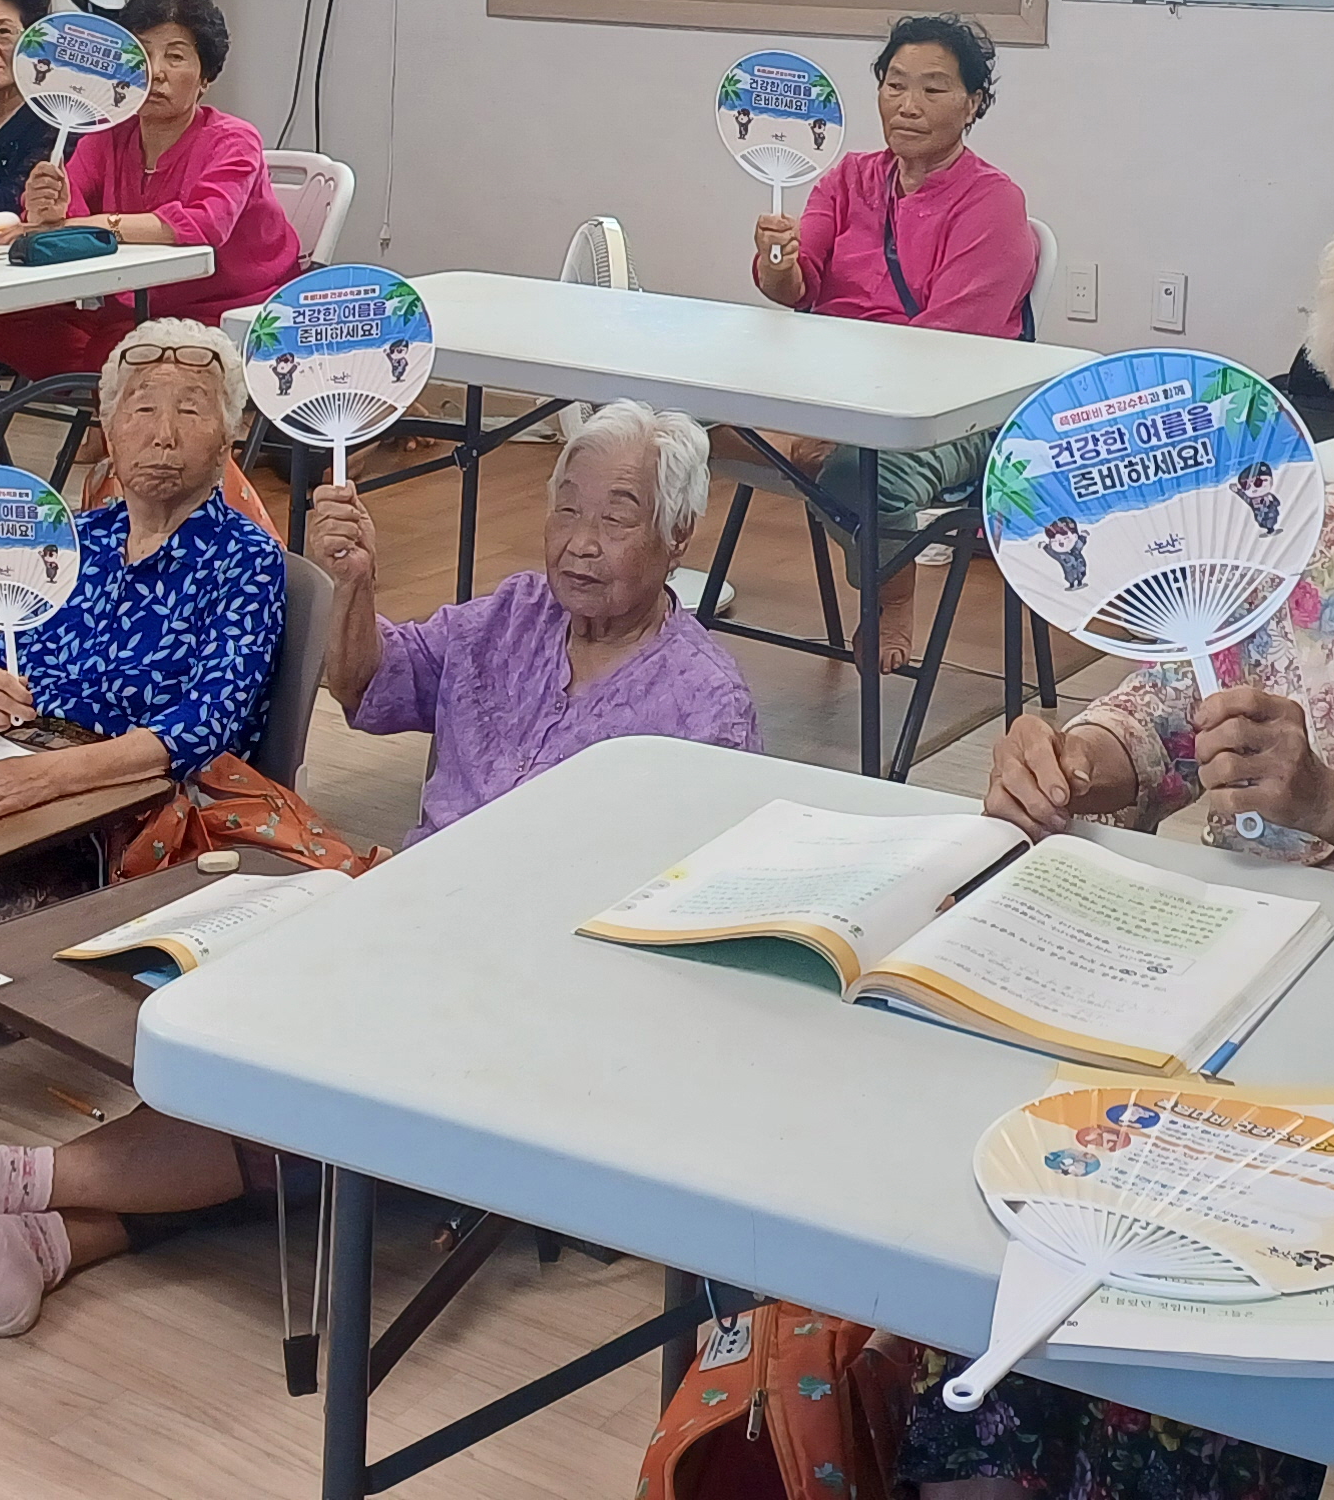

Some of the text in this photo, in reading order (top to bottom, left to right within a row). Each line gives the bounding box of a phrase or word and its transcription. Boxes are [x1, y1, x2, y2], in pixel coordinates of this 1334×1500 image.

[749, 78, 779, 93] 건강한
[754, 94, 807, 111] 준비하세요!
[292, 301, 387, 324] 건강한 여름을
[299, 322, 379, 343] 준비하세요!
[1060, 407, 1103, 426] 폭염대비
[1105, 392, 1160, 414] 건강수칙과
[1049, 404, 1214, 469] 건강한 여름을
[1073, 441, 1212, 499] 준비하세요!
